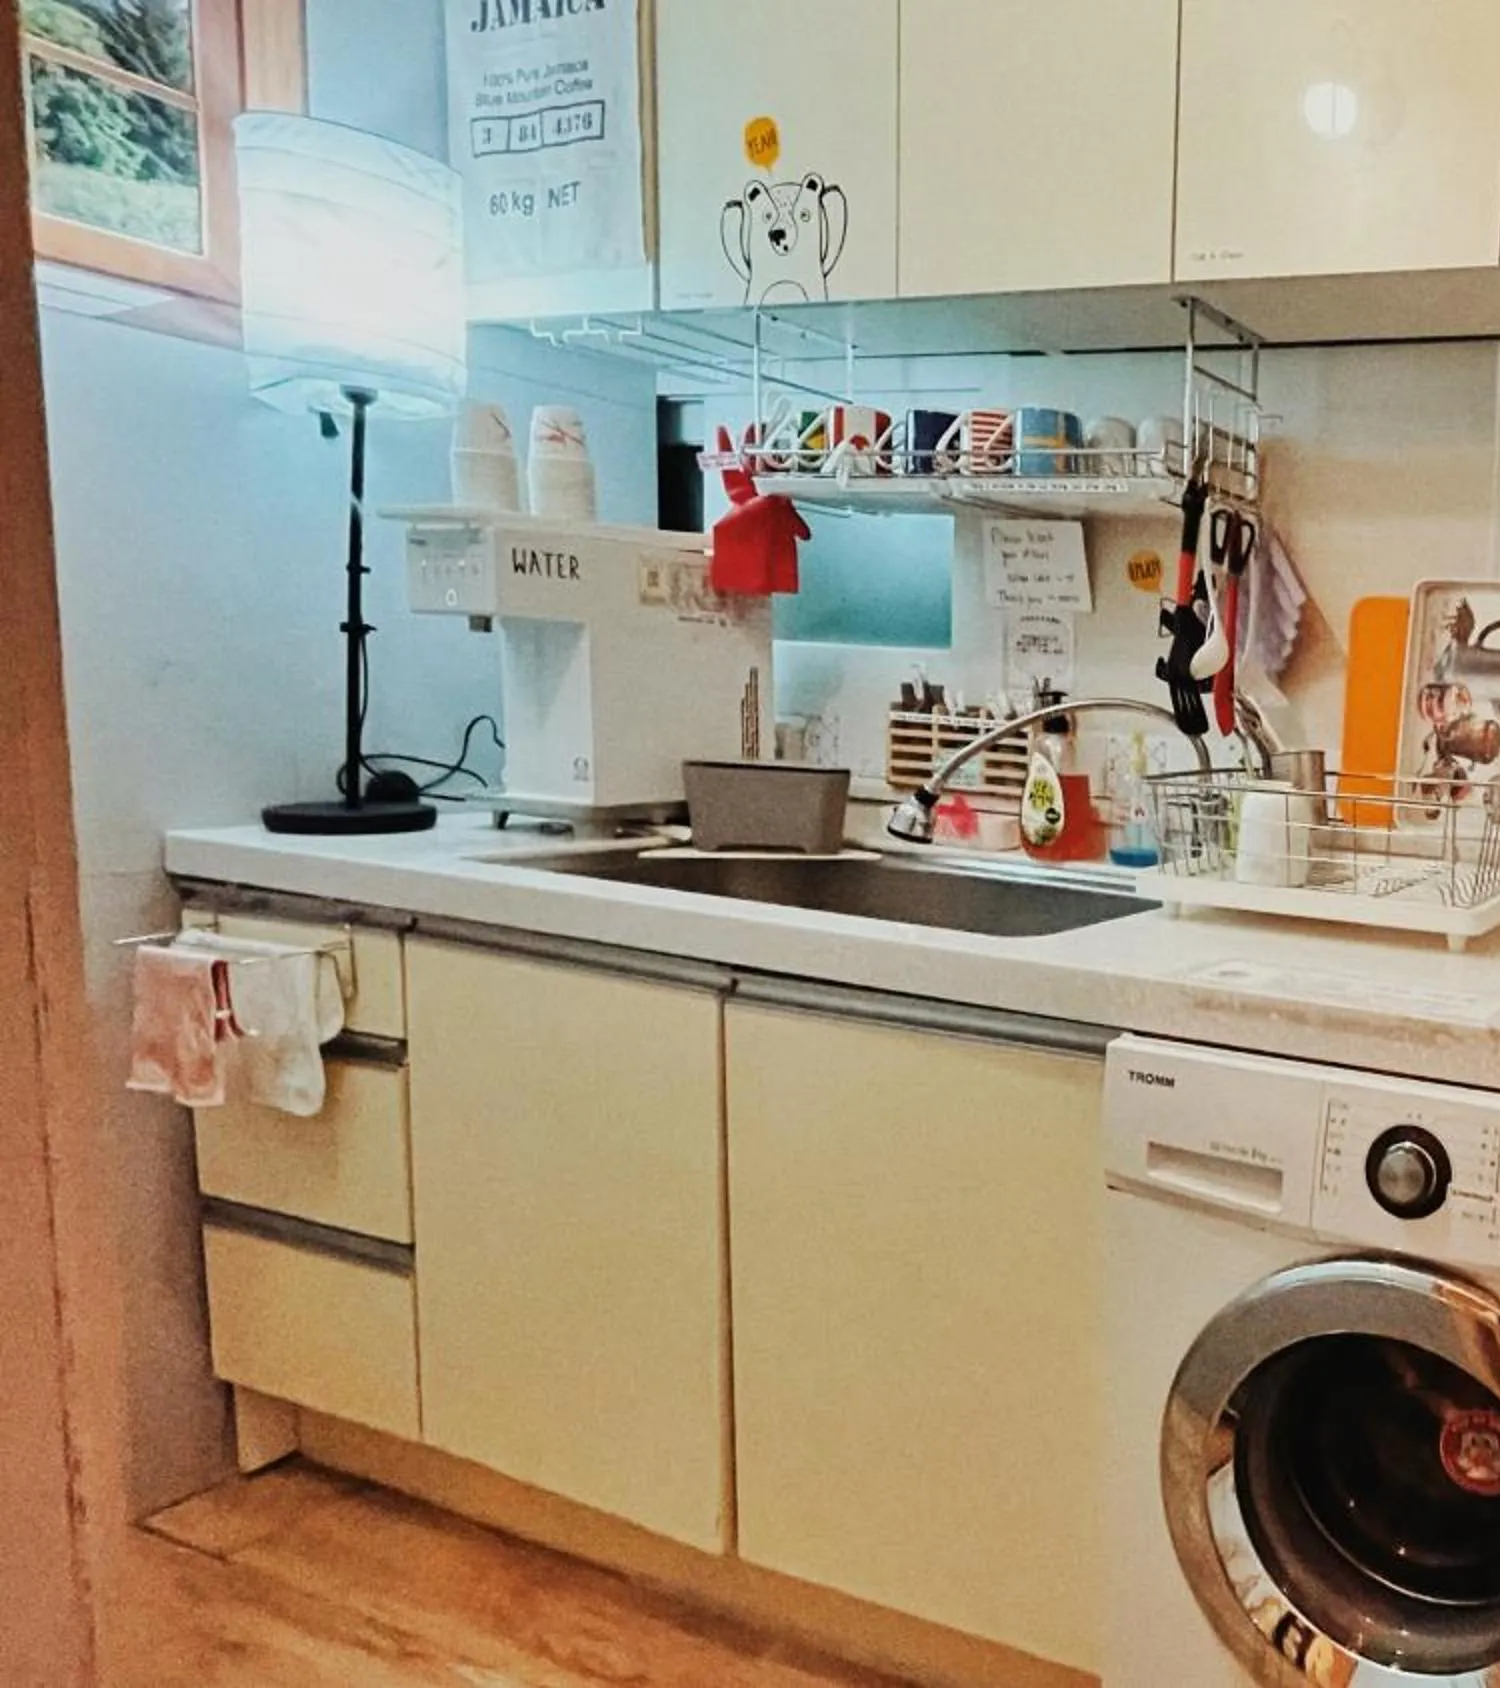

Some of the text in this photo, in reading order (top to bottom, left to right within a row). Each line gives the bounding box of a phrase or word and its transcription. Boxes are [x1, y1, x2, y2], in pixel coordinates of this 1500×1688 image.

[470, 0, 605, 32] JAMA
[554, 79, 593, 95] Coffee
[547, 181, 581, 208] NET
[511, 547, 581, 580] WATER
[1127, 1069, 1175, 1088] TROMM
